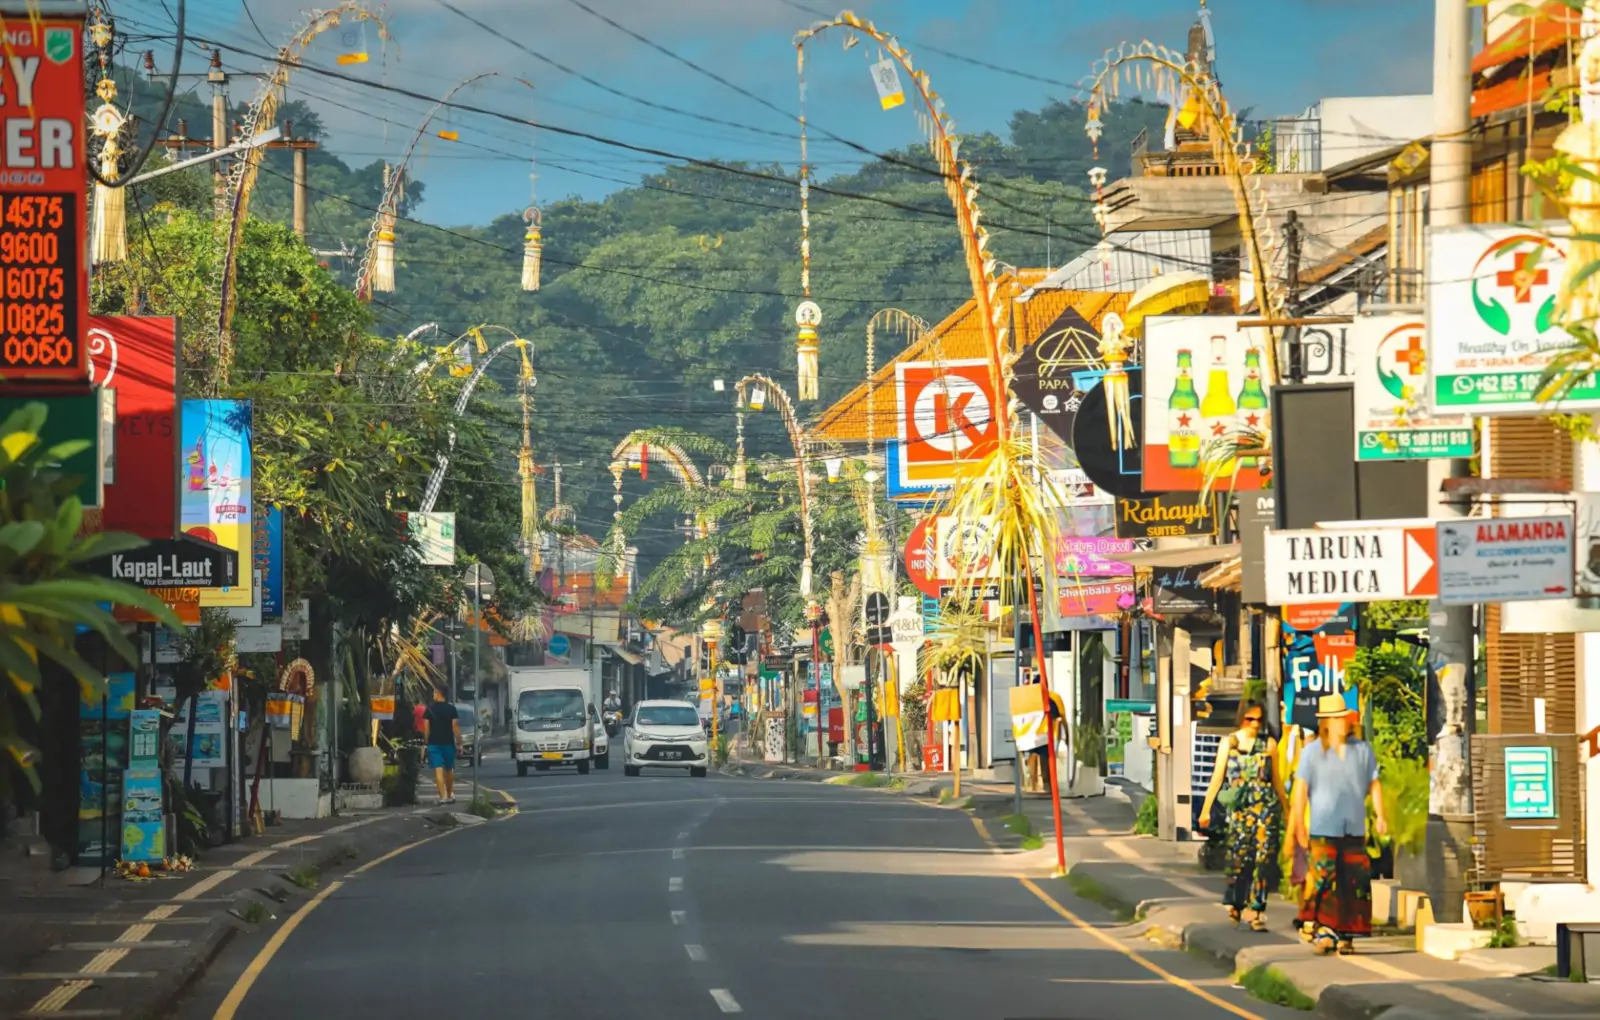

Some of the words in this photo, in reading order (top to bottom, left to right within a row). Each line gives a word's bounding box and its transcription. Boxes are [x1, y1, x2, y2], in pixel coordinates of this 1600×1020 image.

[6, 118, 74, 169] ER
[1458, 342, 1506, 355] Healthy
[1512, 340, 1529, 351] On
[1039, 380, 1069, 390] PAPA
[1476, 375, 1498, 391] +62
[934, 391, 985, 436] K
[1120, 497, 1209, 525] Rahayu
[1146, 525, 1186, 537] SUITES
[1476, 521, 1567, 543] ALAMANDA
[1098, 539, 1130, 552] Dewi
[1287, 534, 1384, 561] TARUNA
[112, 554, 212, 582] Kapal-Laut
[143, 578, 157, 586] Your
[158, 578, 183, 586] Essential
[1287, 569, 1382, 595] MEDICA
[154, 588, 199, 602] SILVER
[974, 588, 996, 598] STRE
[1060, 586, 1111, 598] Shambala
[1114, 583, 1134, 595] Spa
[1291, 654, 1346, 693] Folk
